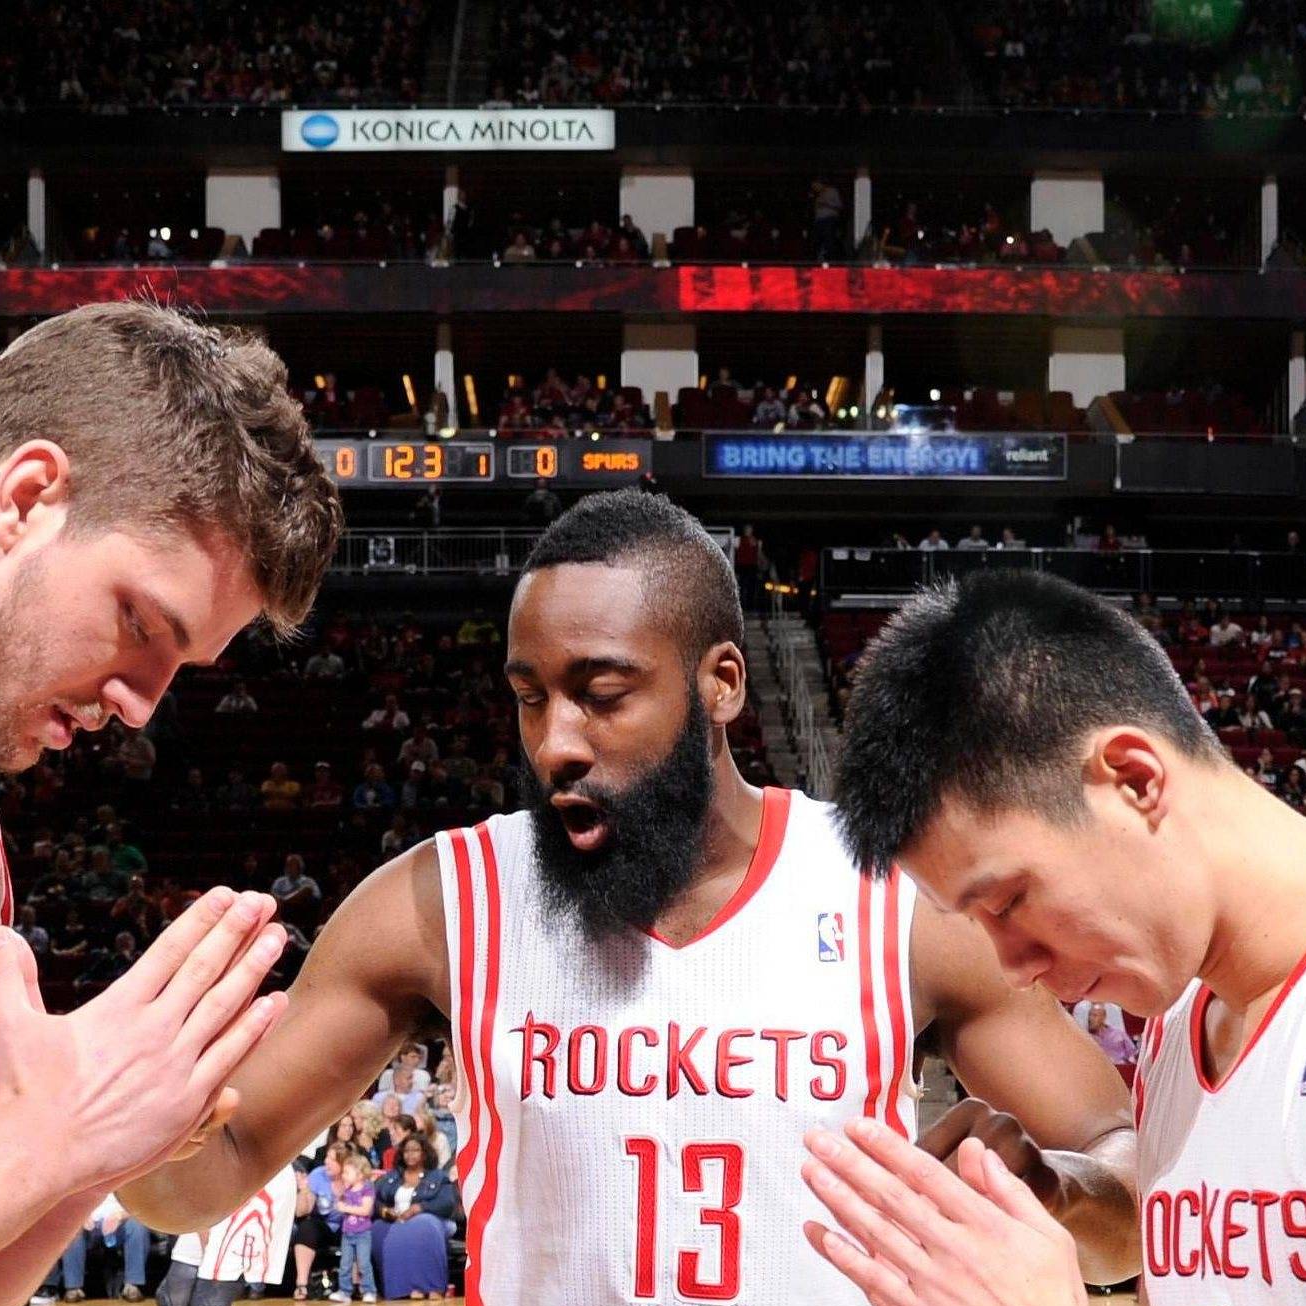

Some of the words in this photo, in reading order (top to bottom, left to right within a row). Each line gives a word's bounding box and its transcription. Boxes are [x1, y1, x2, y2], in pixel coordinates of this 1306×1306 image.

[352, 119, 462, 142] KONICA
[470, 119, 595, 141] MINOLTA
[535, 447, 554, 478] 0
[582, 453, 639, 471] SPURS
[723, 445, 806, 468] BRING
[810, 445, 861, 468] THE
[867, 445, 979, 469] ENERGY!
[508, 1010, 849, 1102] ROCKETS
[625, 1137, 745, 1300] 13
